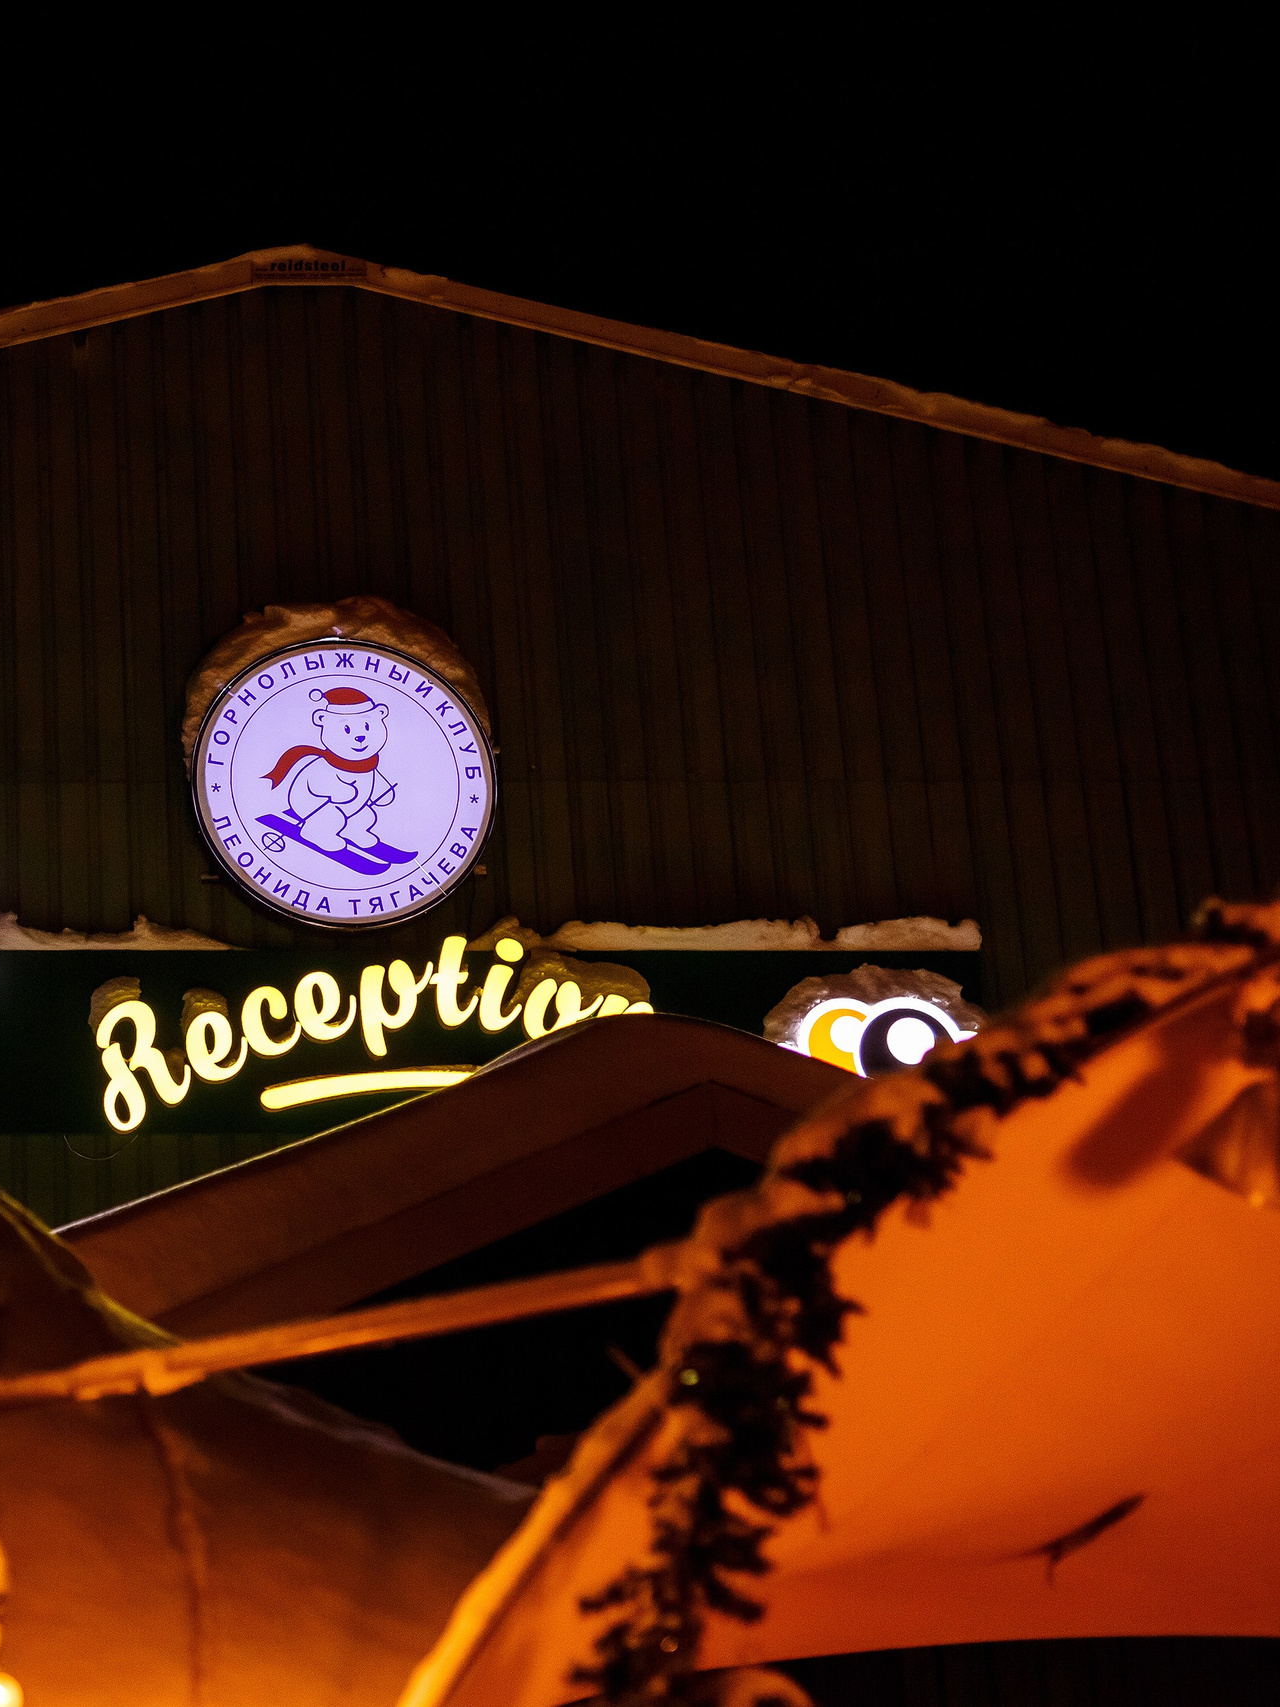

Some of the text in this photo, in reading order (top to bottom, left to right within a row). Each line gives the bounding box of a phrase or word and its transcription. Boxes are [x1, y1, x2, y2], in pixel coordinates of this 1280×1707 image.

[270, 259, 346, 272] reidsteel
[208, 652, 482, 780] ГОРНОЛЫЖНЫЙ КЛУБ
[212, 815, 478, 915] ЛЕОНИДА ТЯГАЧЕВА
